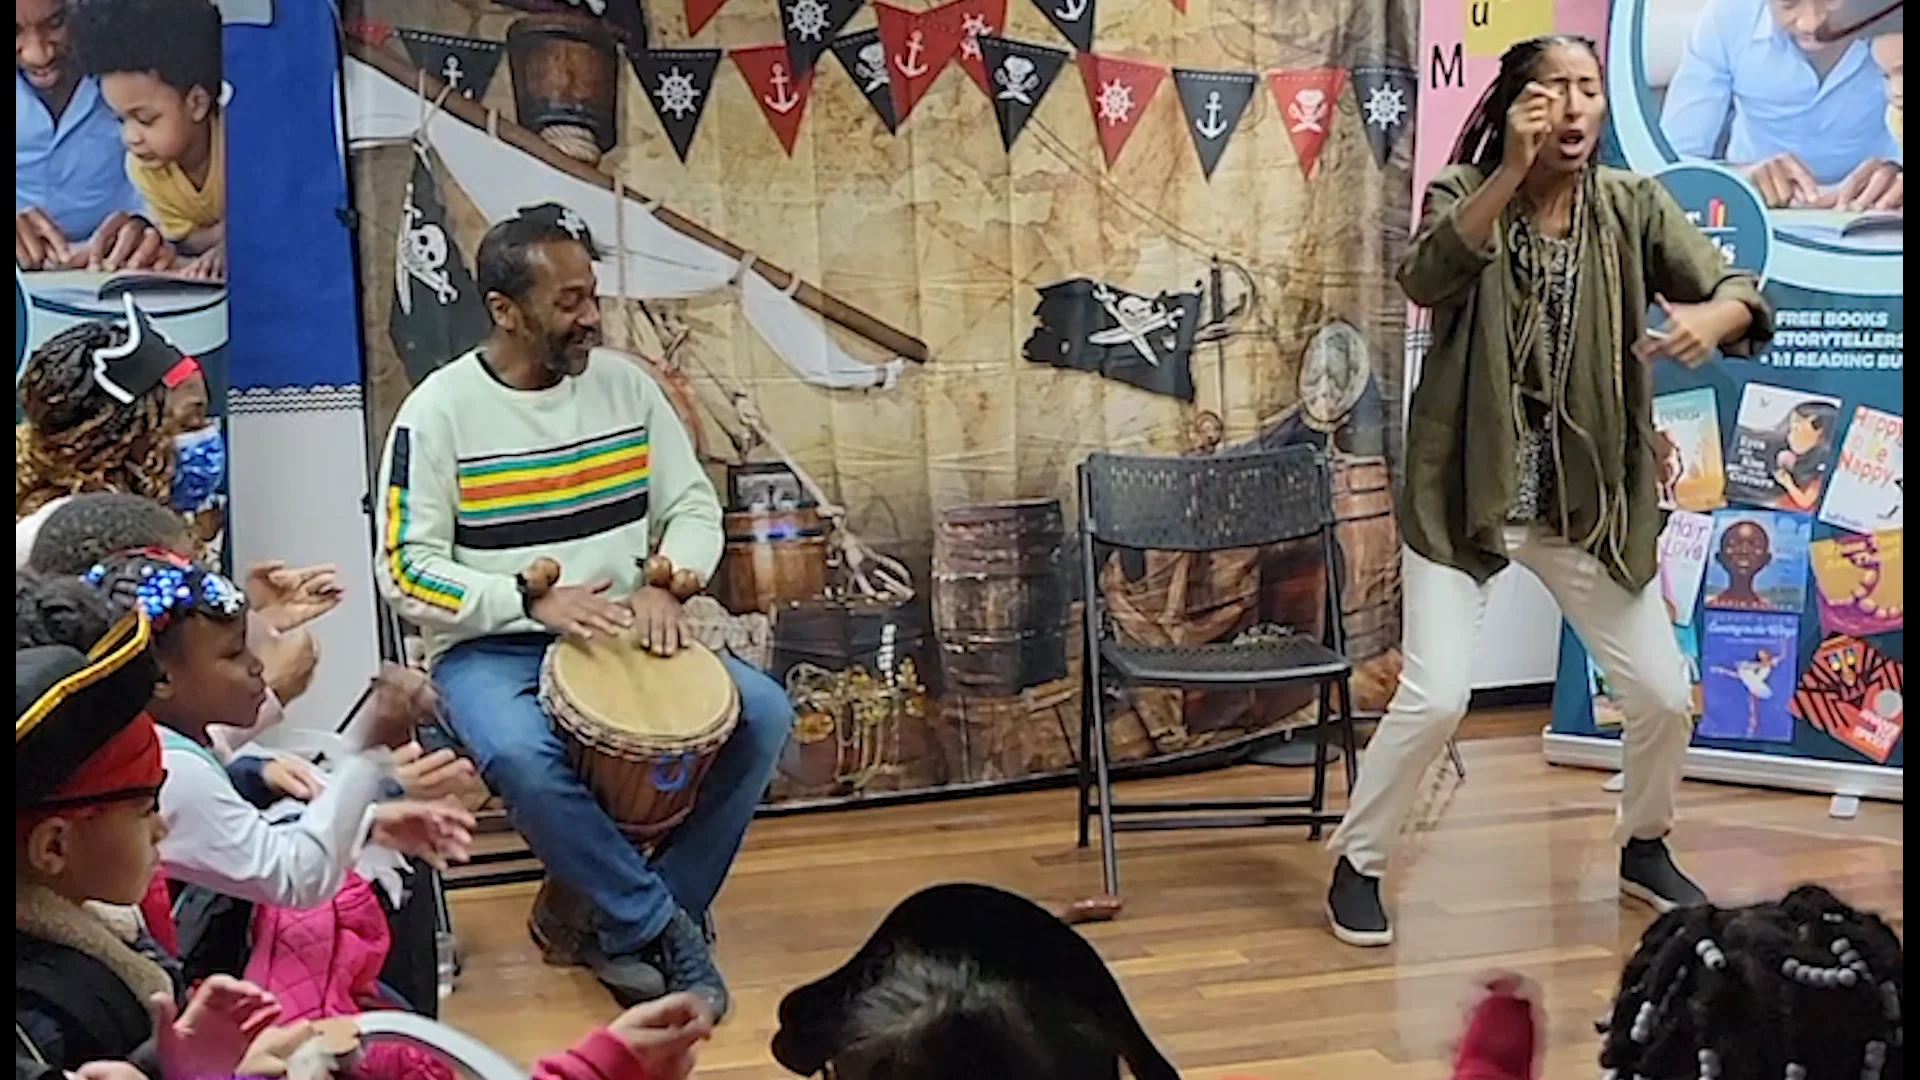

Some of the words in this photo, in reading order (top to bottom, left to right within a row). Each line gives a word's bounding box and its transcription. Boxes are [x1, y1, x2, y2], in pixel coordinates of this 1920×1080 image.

[1473, 2, 1489, 27] u
[1431, 43, 1464, 89] M
[1775, 311, 1822, 327] FREE
[1824, 311, 1888, 328] BOOKS
[1793, 351, 1875, 368] READING
[1671, 513, 1710, 541] Hair
[1663, 536, 1703, 561] Love
